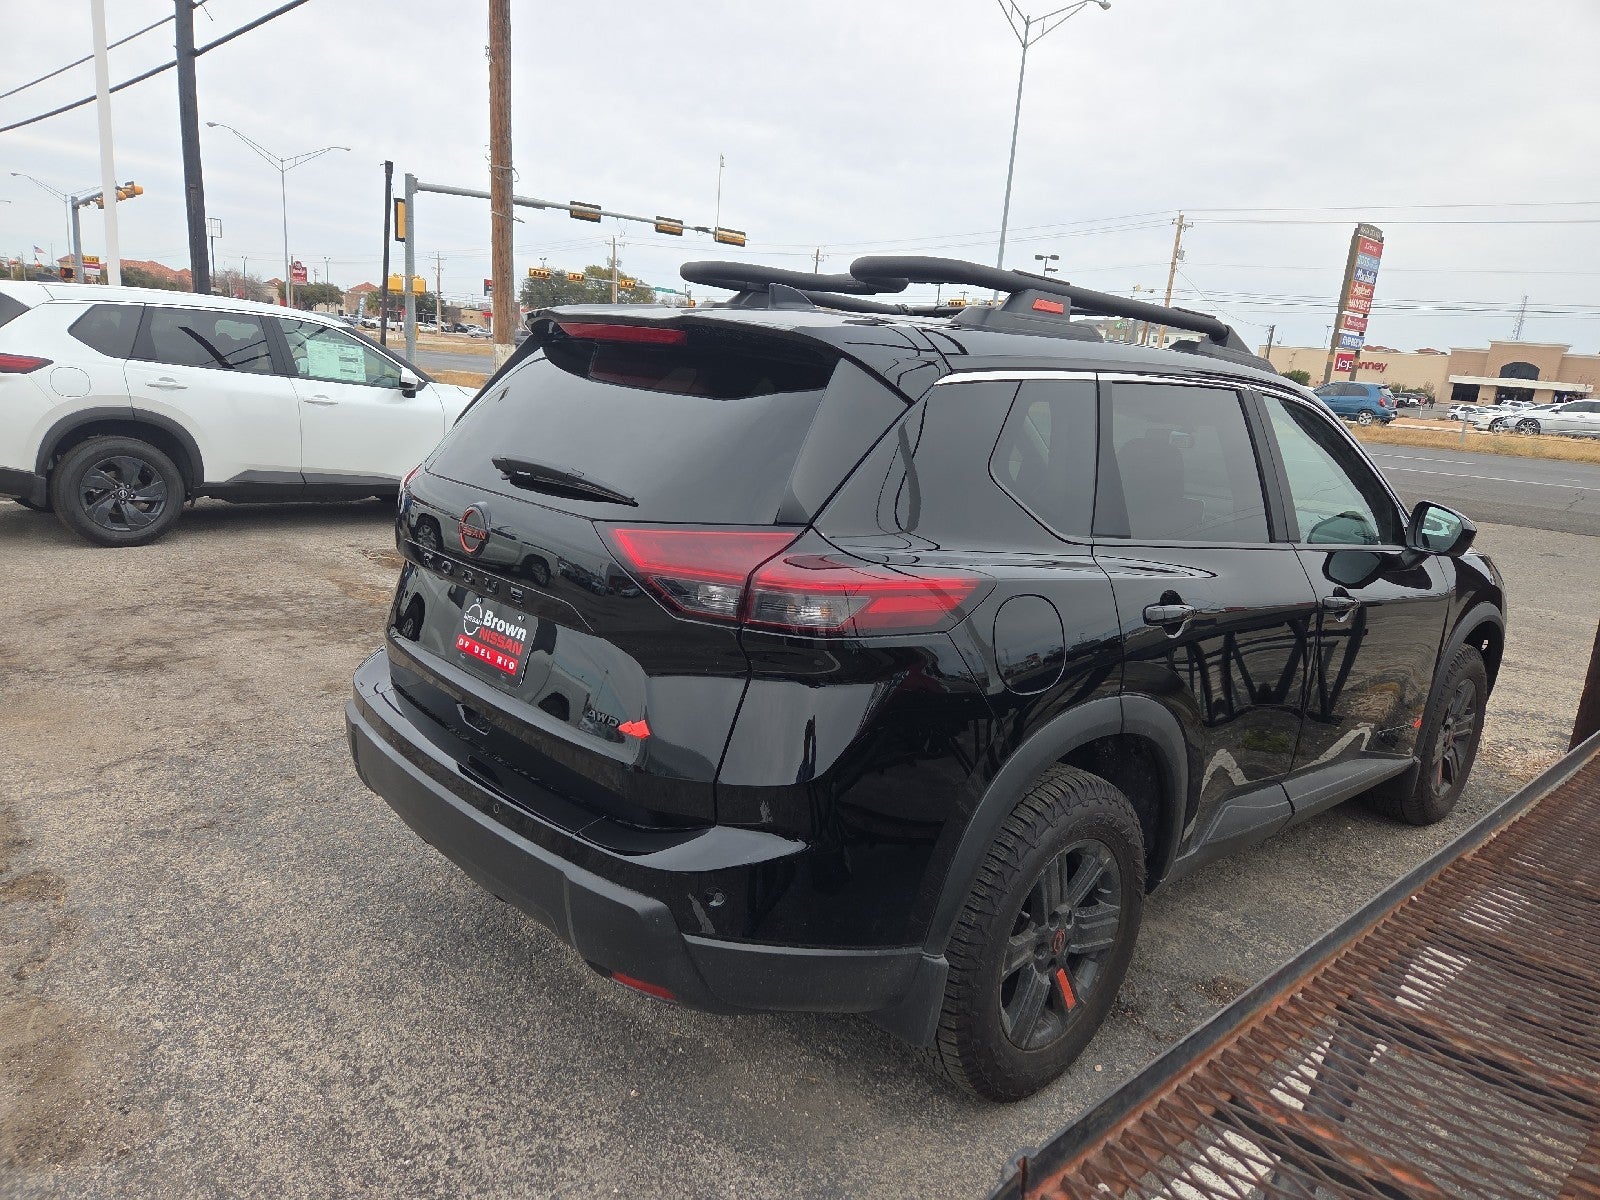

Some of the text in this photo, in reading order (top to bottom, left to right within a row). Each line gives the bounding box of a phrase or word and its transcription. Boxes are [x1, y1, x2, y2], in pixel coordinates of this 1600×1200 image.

[1336, 358, 1388, 373] jcpnney
[423, 552, 523, 604] ROGUE
[483, 609, 527, 641] Brown
[479, 626, 524, 656] NISSAN
[474, 645, 491, 660] DEL
[496, 655, 515, 670] RIO
[586, 709, 620, 728] AWD
